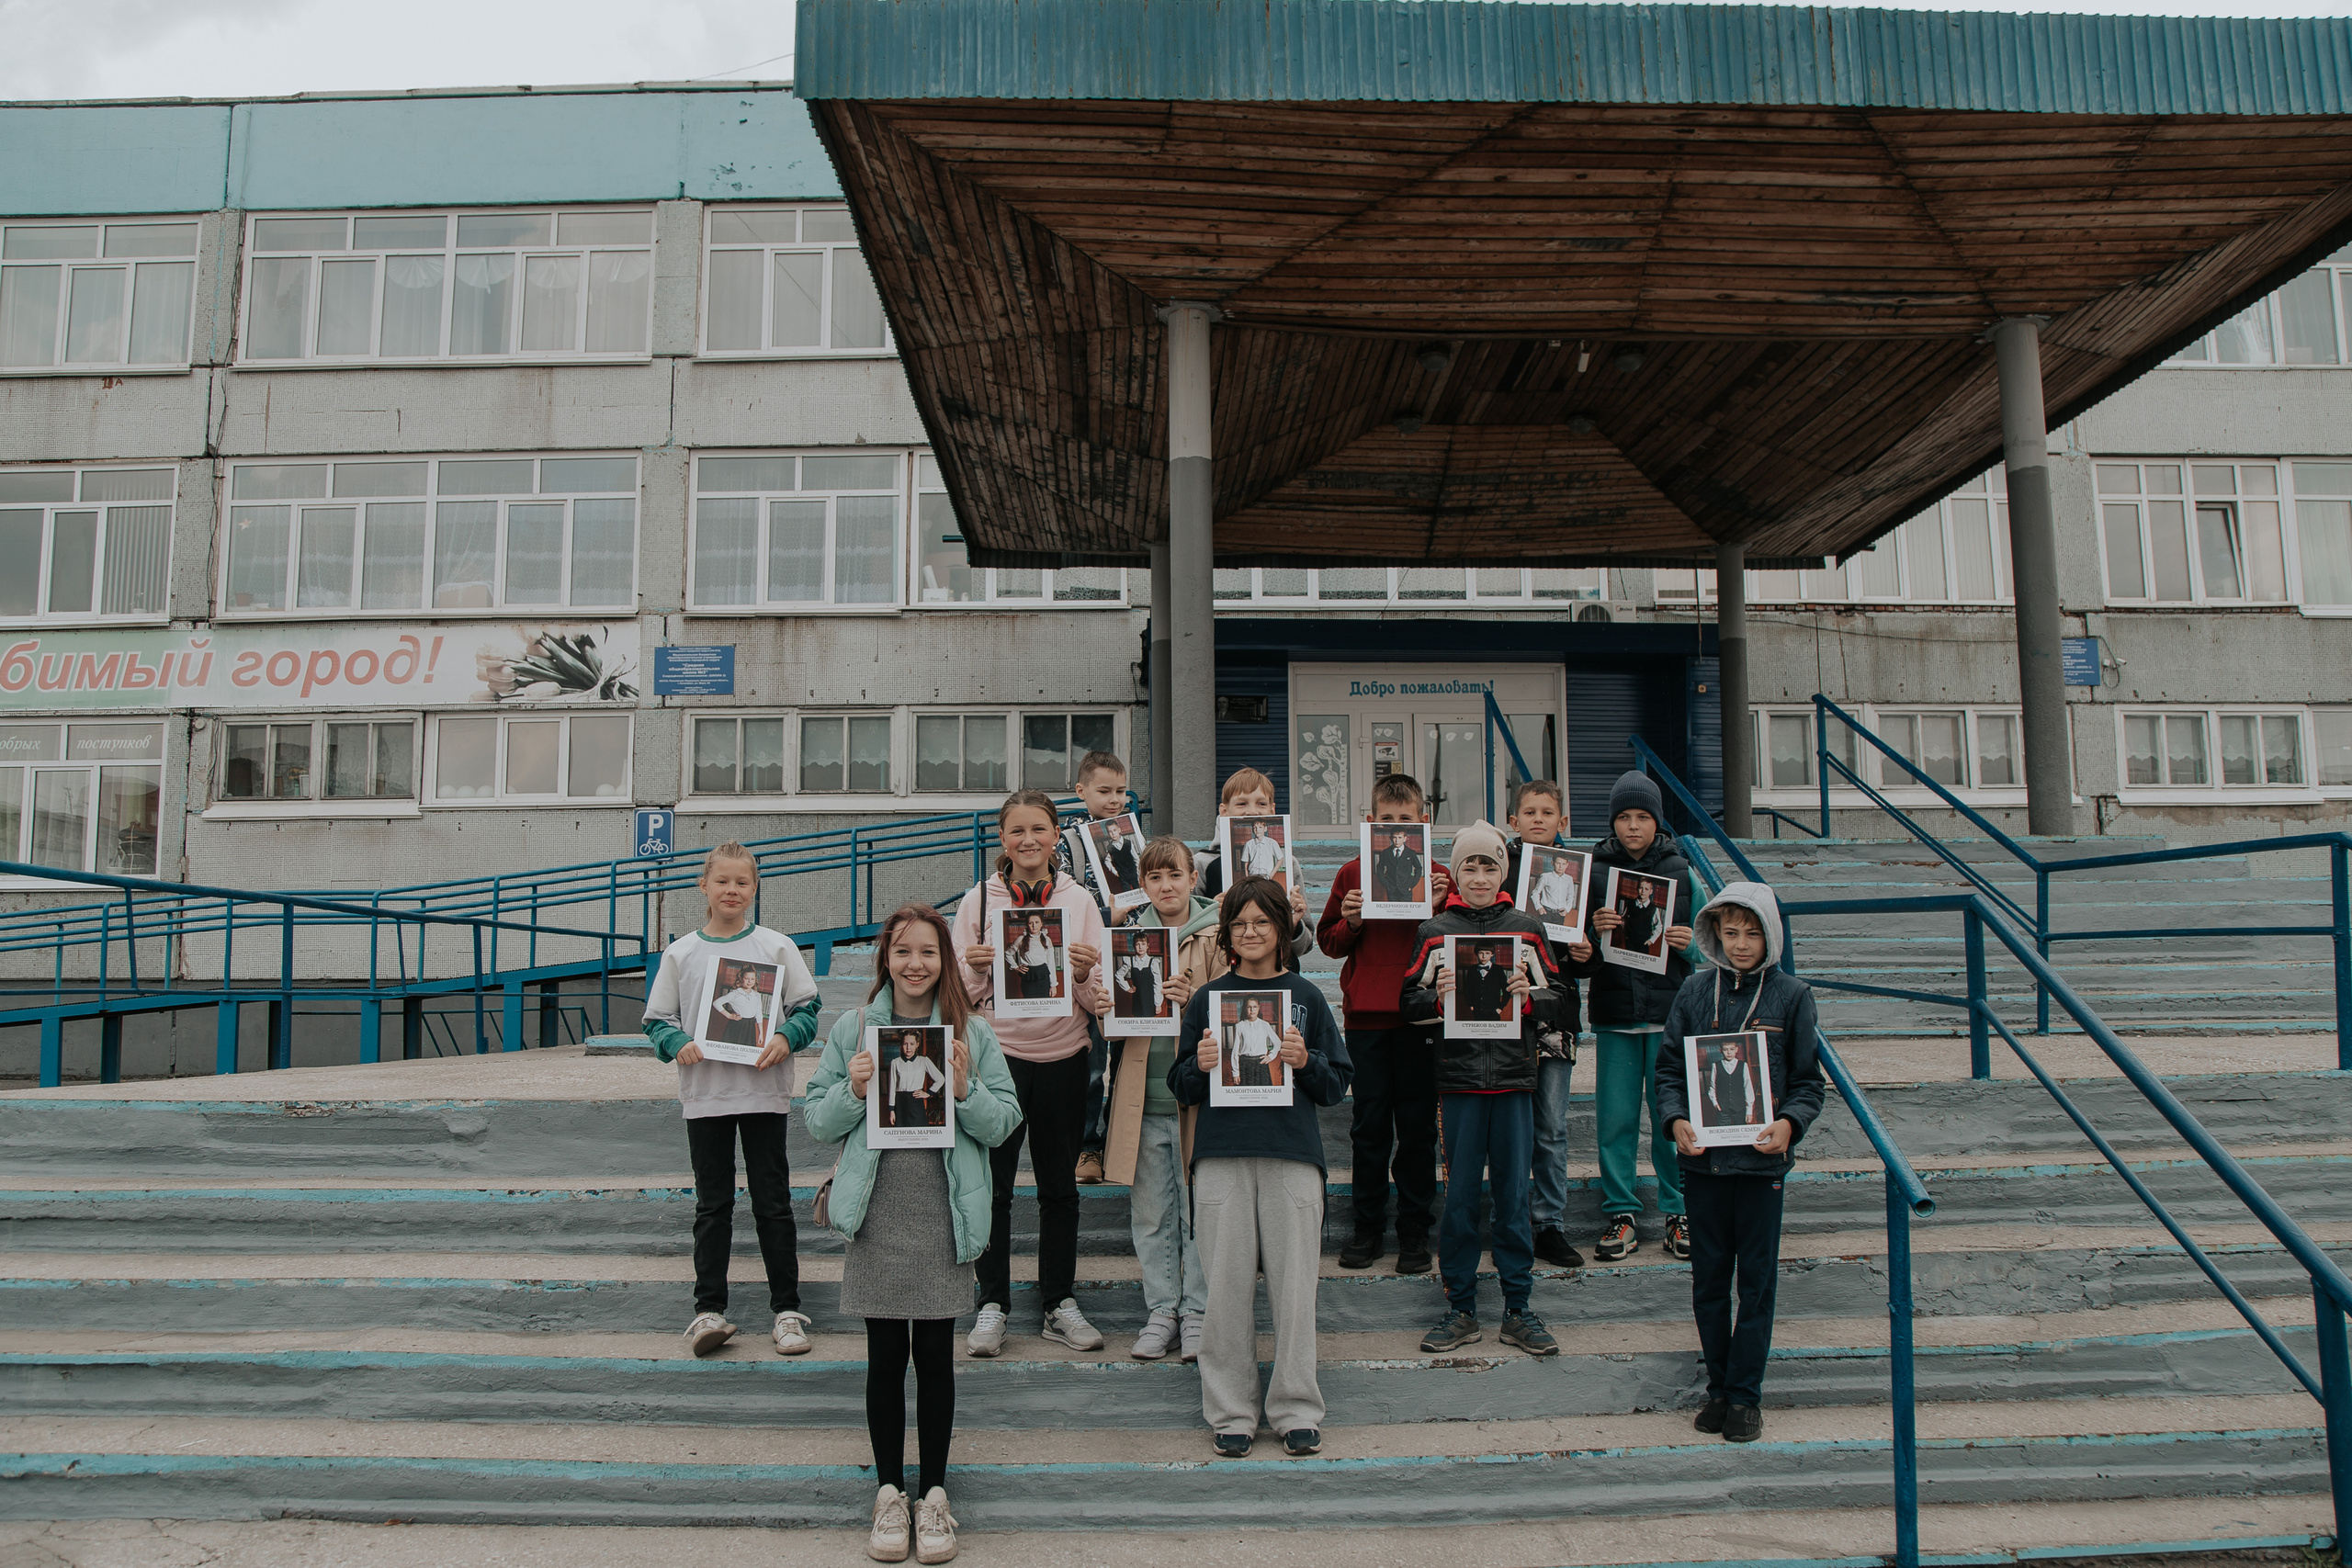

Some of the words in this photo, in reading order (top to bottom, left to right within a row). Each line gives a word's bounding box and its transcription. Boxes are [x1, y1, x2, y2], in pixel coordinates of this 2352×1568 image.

[231, 635, 445, 698] город!
[1349, 681, 1396, 698] Добро
[1400, 679, 1495, 694] пожаловать!
[76, 735, 152, 751] поступков
[649, 814, 664, 837] P
[1638, 954, 1657, 963] СЕРГЕЙ
[706, 1042, 740, 1052] ФЕОФАНОВА
